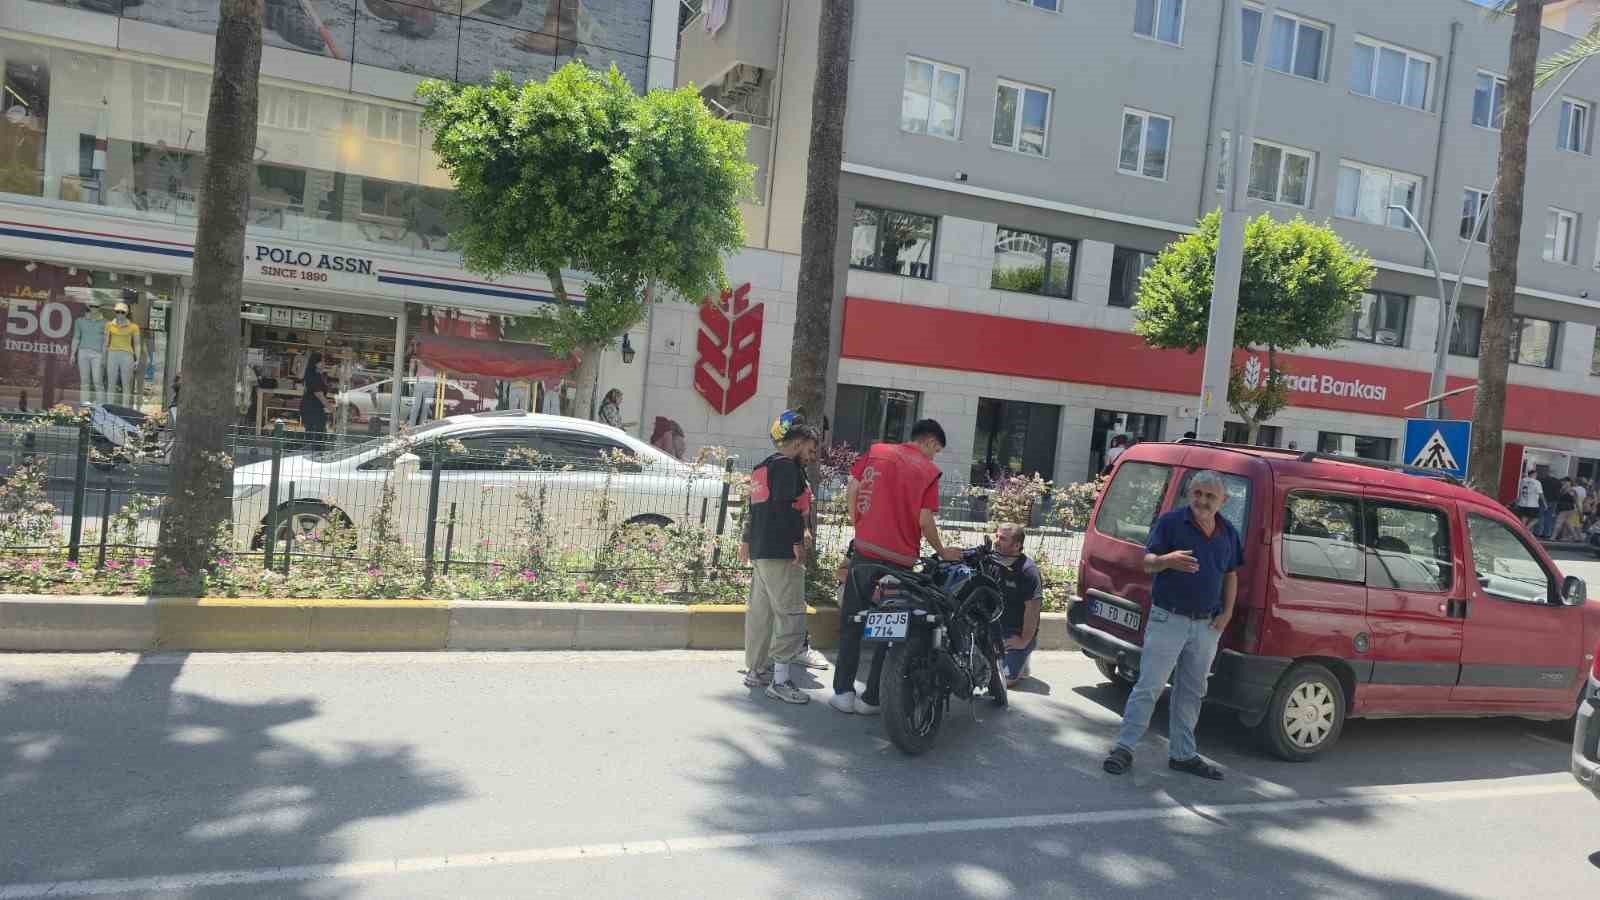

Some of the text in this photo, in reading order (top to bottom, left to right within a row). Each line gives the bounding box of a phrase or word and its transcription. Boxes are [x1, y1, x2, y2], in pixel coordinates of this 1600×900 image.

[255, 245, 377, 276] POLO ASSN.
[260, 265, 297, 279] SINCE
[6, 301, 73, 338] 50
[1320, 375, 1387, 401] Bankası
[869, 614, 907, 625] 07 CJS
[874, 626, 893, 637] 714
